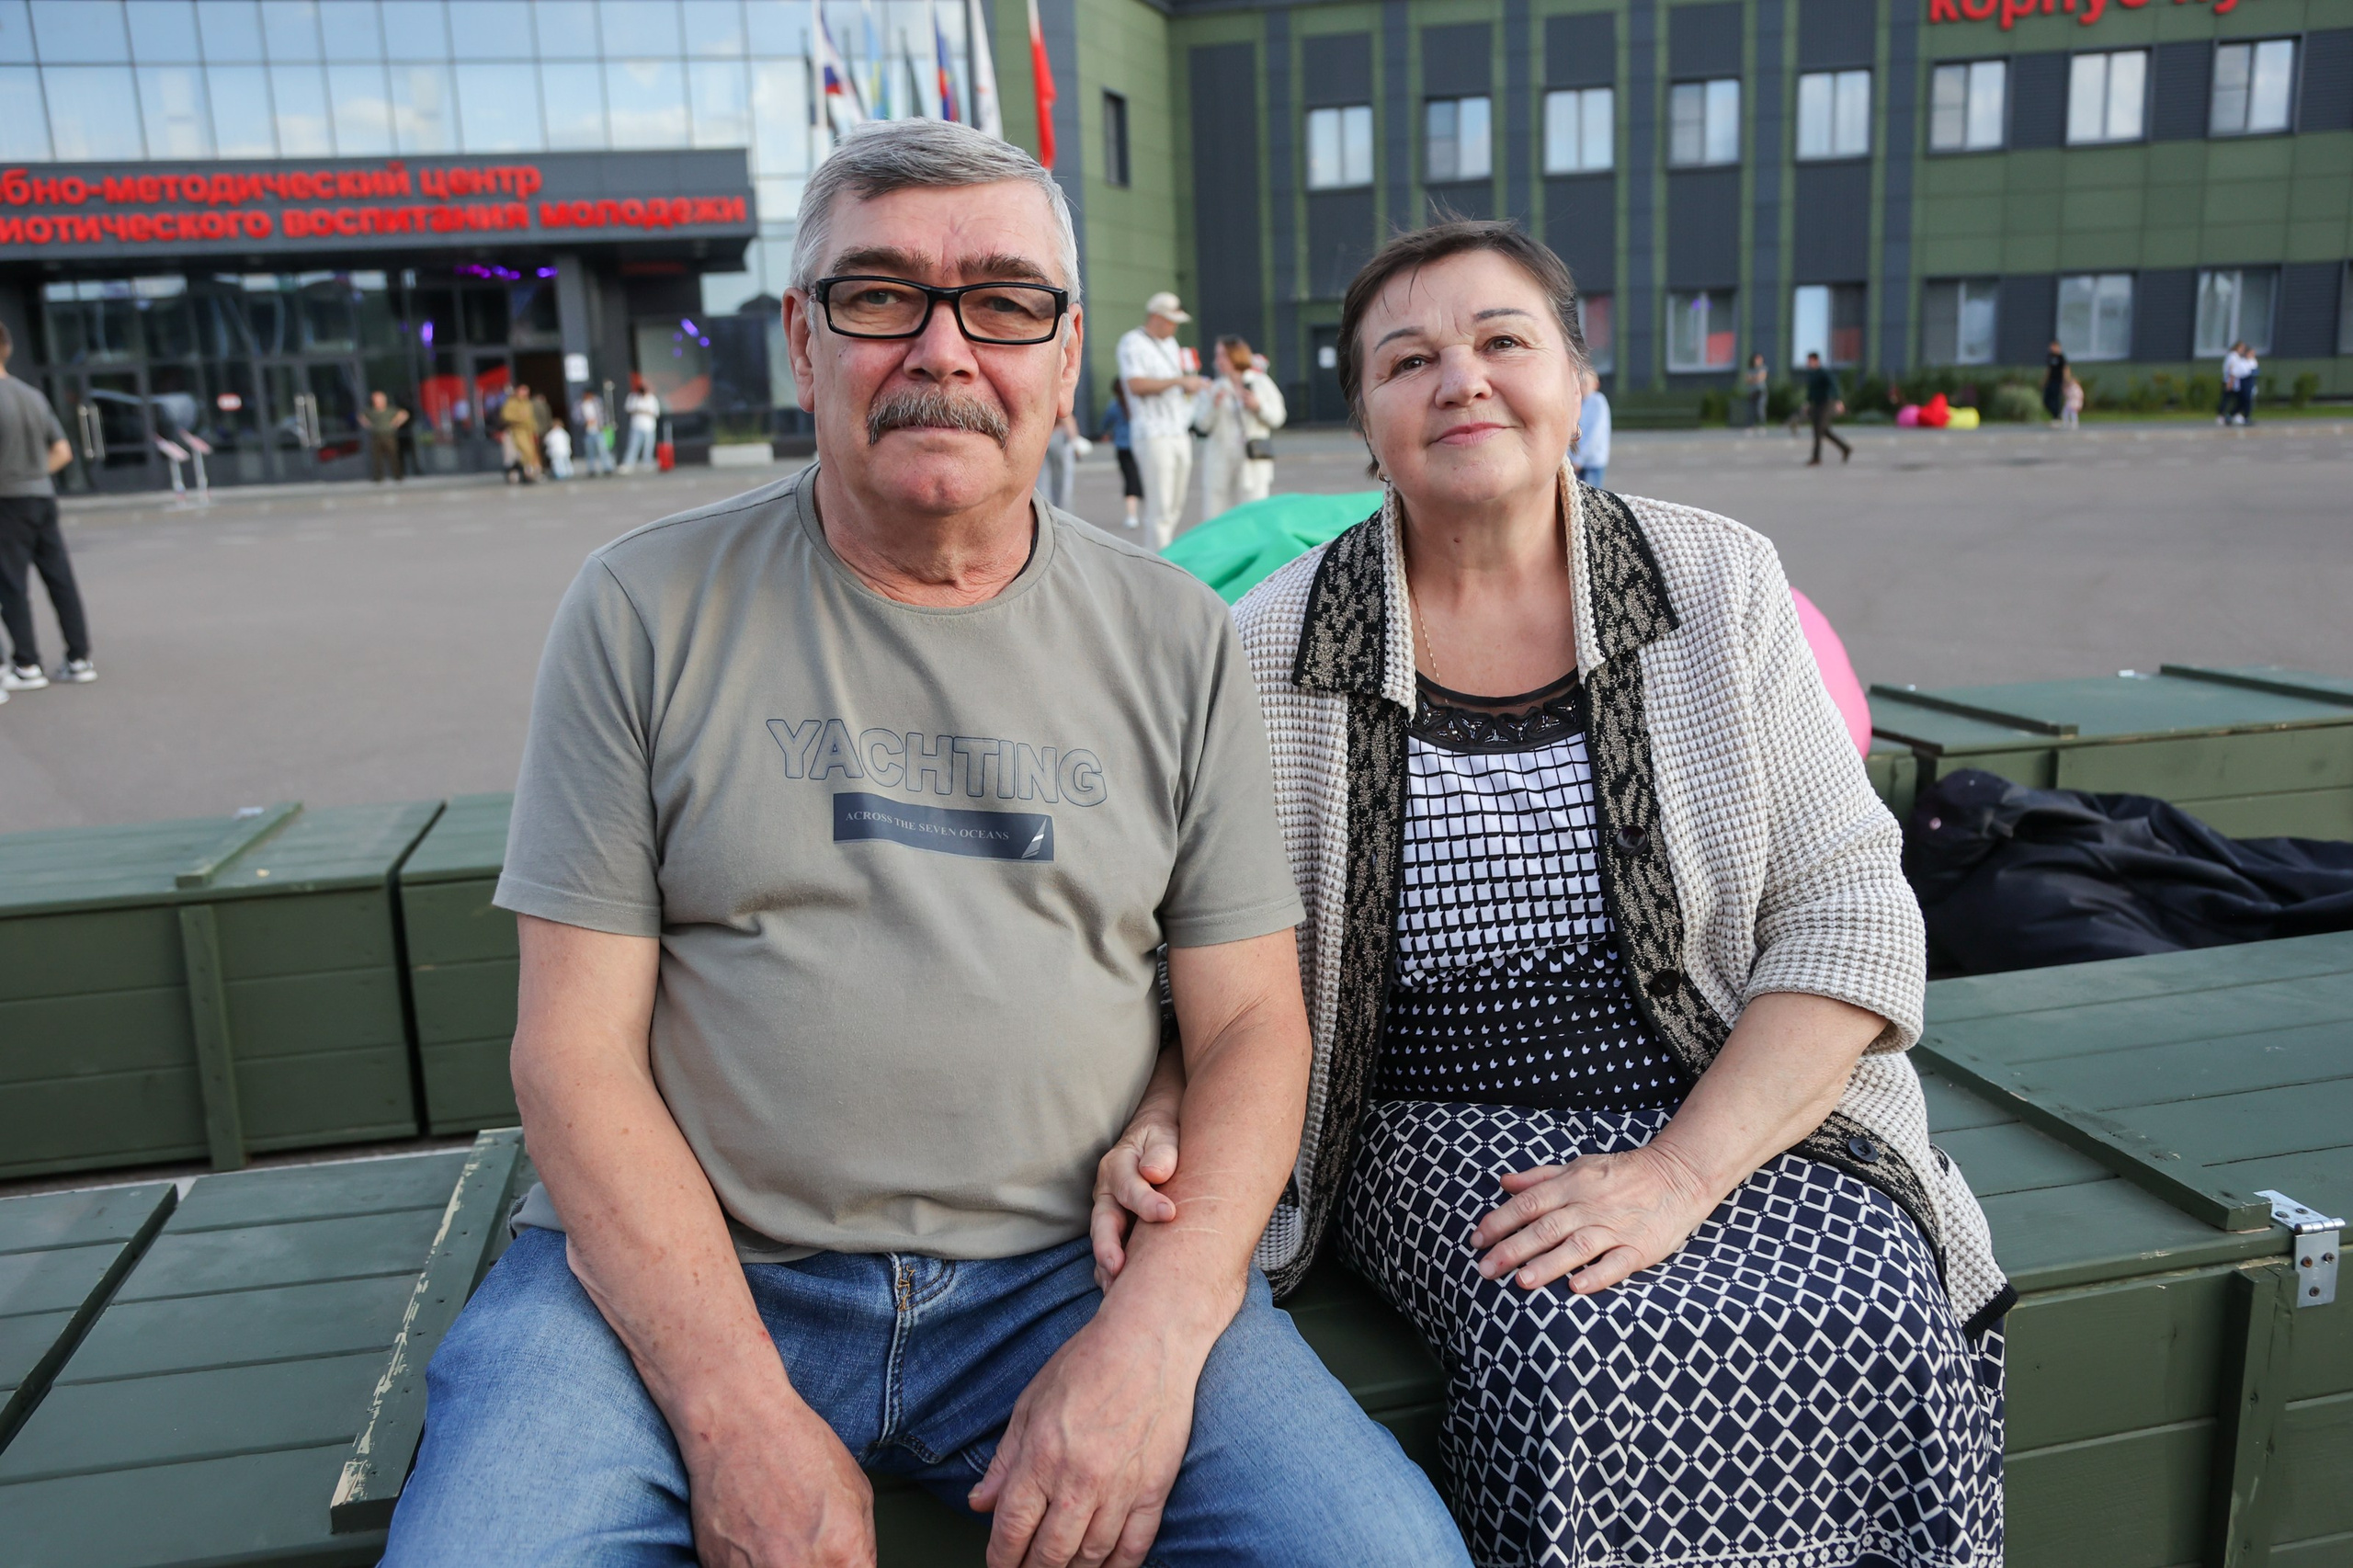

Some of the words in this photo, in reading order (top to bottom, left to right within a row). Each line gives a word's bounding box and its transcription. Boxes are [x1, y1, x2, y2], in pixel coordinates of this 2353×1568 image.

[0, 161, 412, 208] бно-методический
[419, 165, 542, 202] центр
[281, 201, 530, 239] воспитания
[539, 195, 747, 231] молодежи
[766, 719, 1107, 807] YACHTING
[846, 812, 892, 824] ACROSS
[894, 817, 916, 831] THE
[919, 824, 956, 837] SEVEN
[960, 829, 1009, 840] OCEANS
